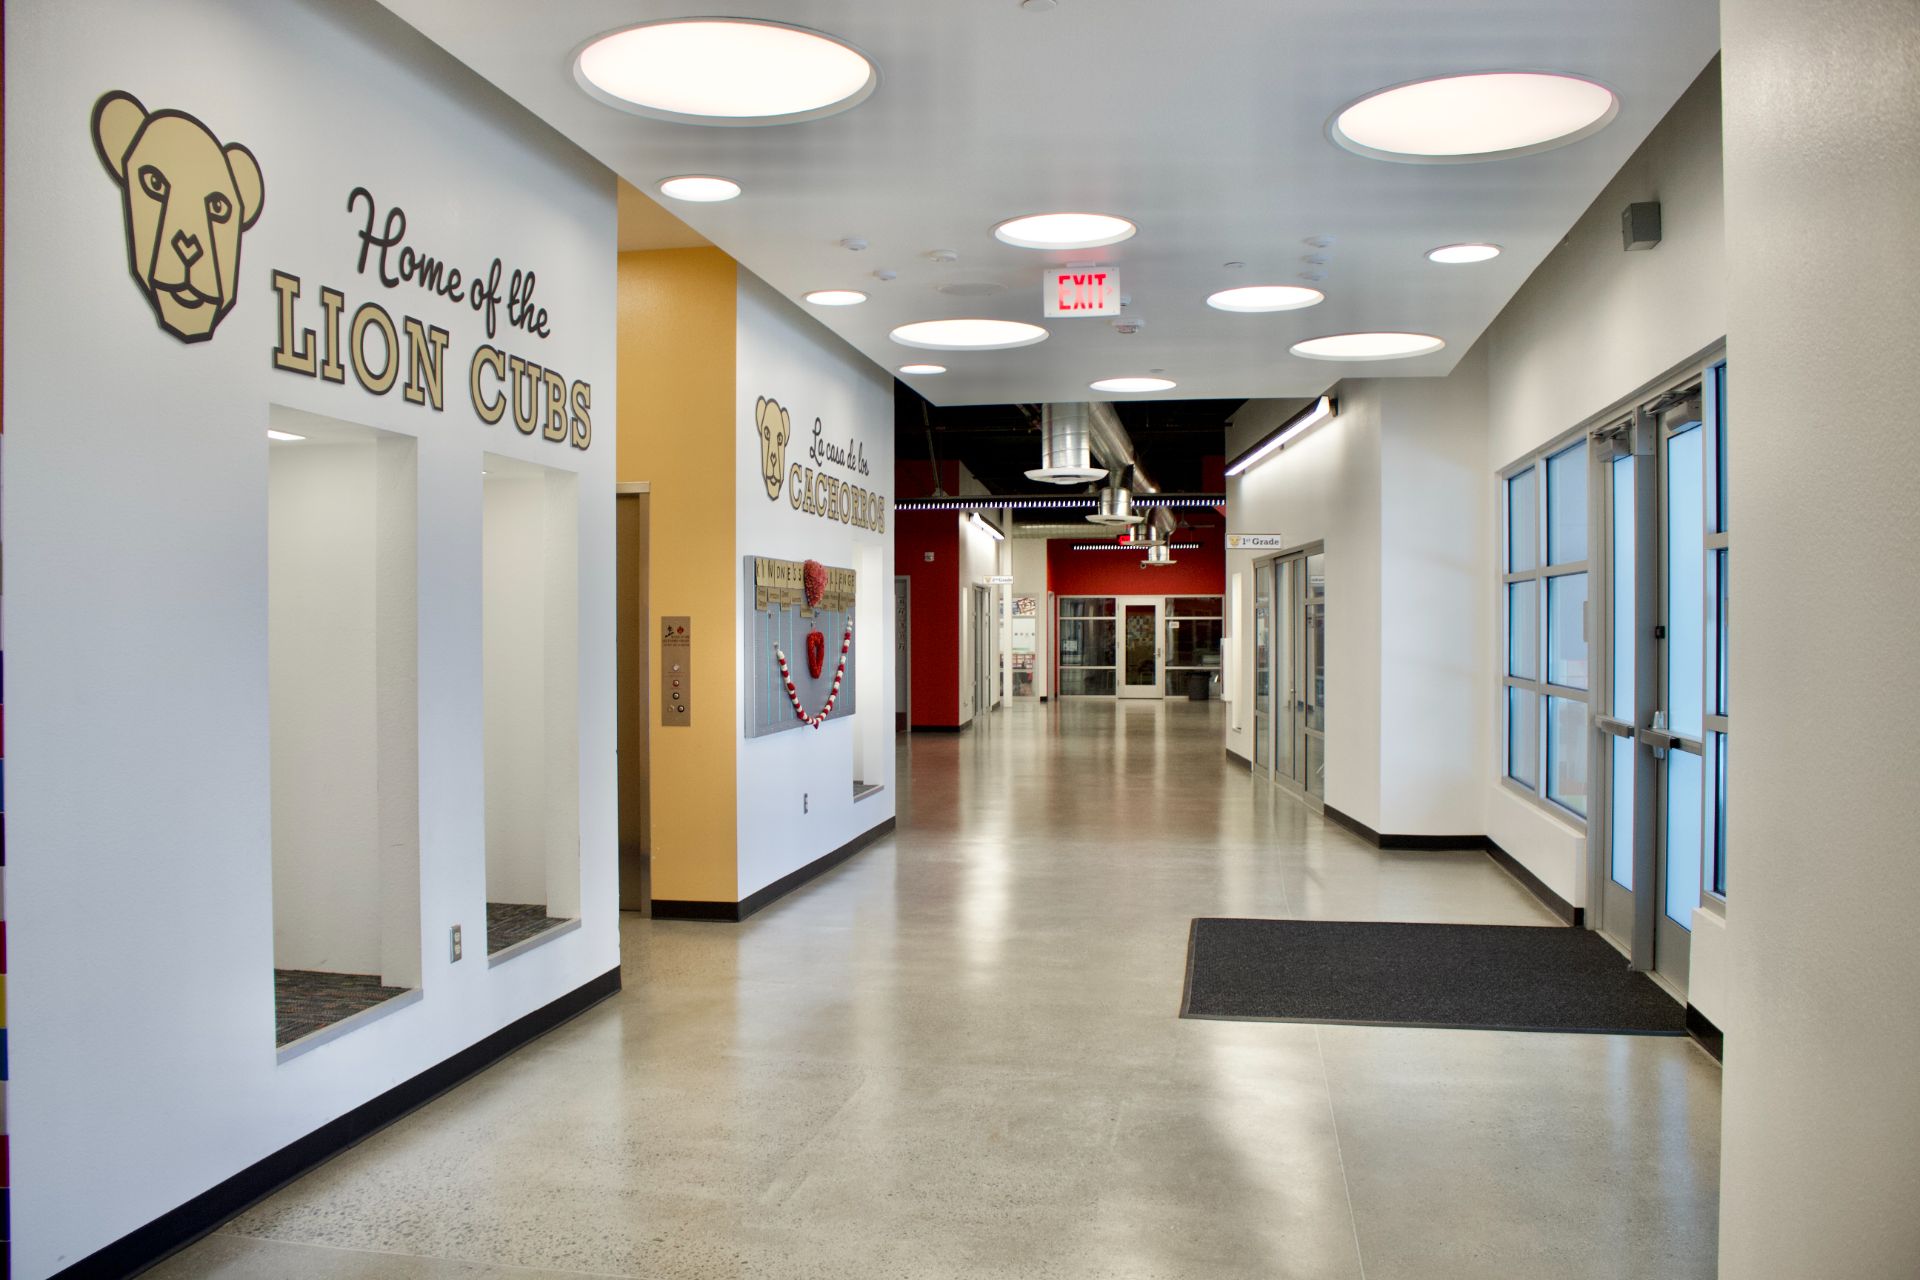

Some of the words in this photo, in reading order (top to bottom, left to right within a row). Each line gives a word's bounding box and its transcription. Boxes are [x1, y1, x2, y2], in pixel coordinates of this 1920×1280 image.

[347, 186, 465, 303] Home
[470, 257, 502, 340] of
[507, 268, 551, 340] the
[1058, 273, 1107, 310] EXIT
[272, 268, 449, 411] LION
[470, 344, 592, 451] CUBS
[809, 416, 825, 468] La
[826, 442, 846, 467] casa
[847, 438, 857, 471] de
[858, 441, 870, 477] los
[789, 462, 885, 534] CACHORROS
[1252, 537, 1279, 546] Grade
